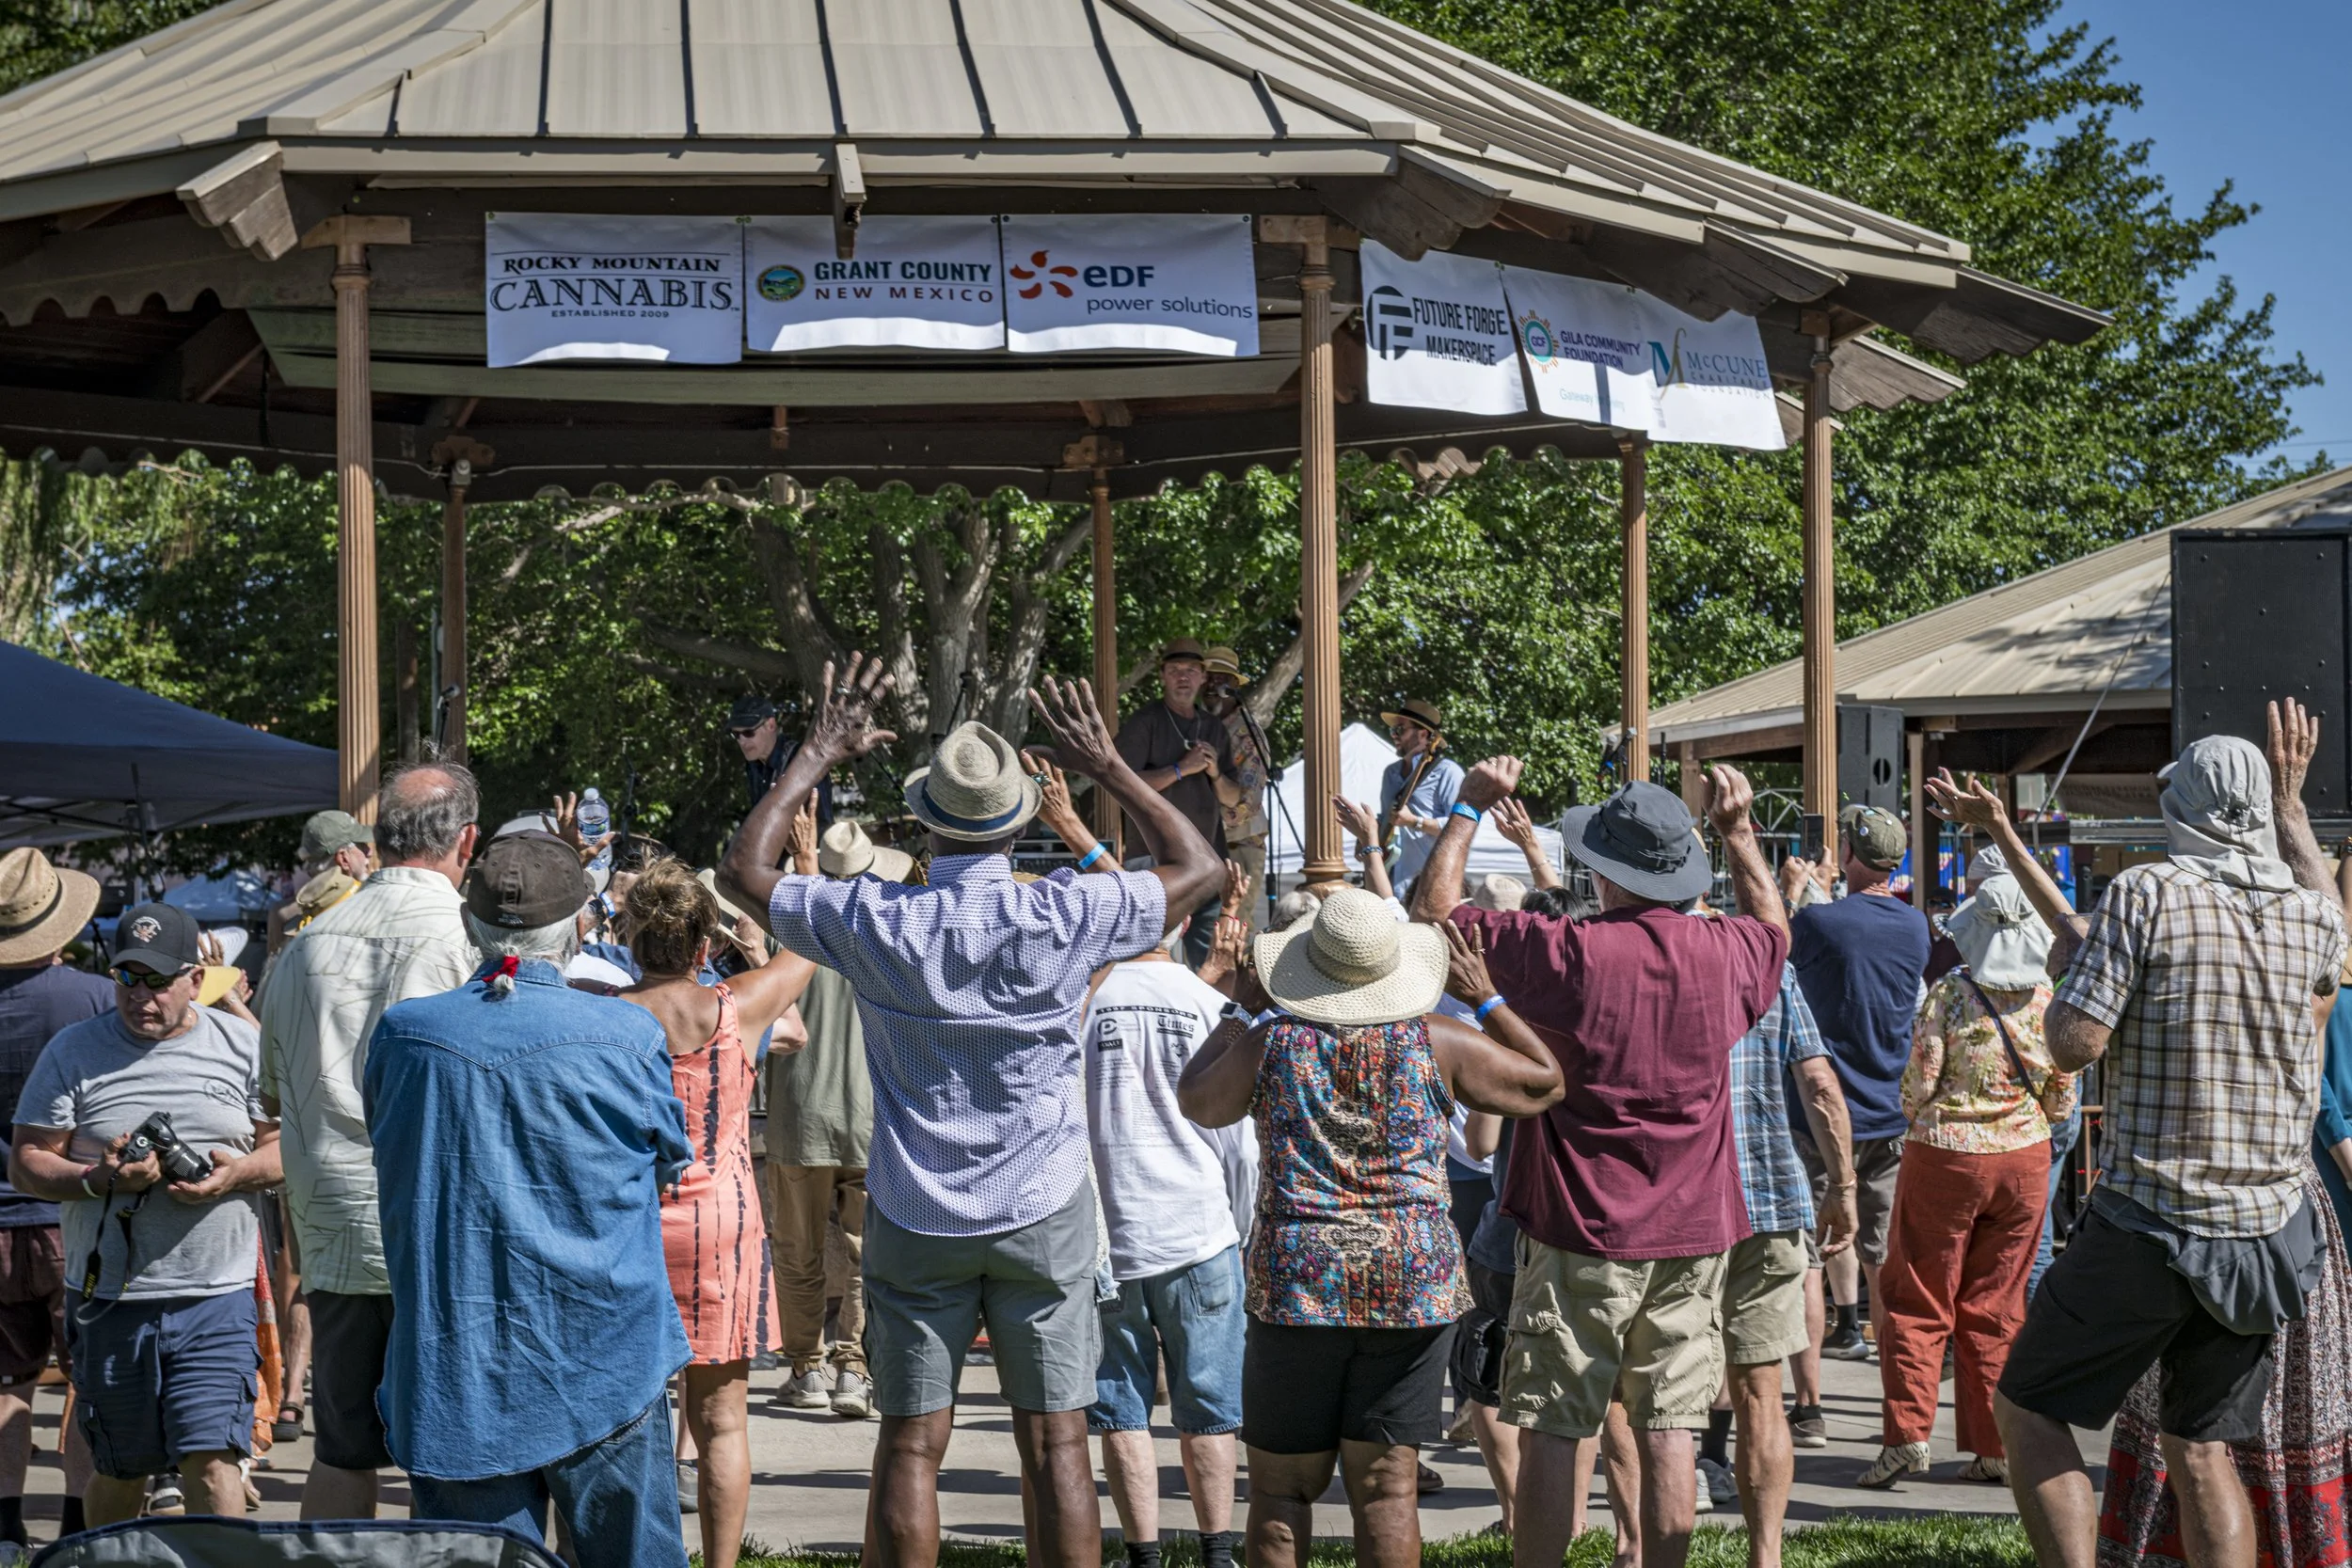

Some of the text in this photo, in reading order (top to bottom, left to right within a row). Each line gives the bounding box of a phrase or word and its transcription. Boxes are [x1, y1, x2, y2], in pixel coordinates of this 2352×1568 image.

[503, 256, 722, 275] ROCKY MOUNTAIN
[814, 261, 992, 282] GRANT COUNTY
[489, 278, 734, 311] CANNABIS
[816, 287, 993, 303] NEW MEXICO
[551, 309, 636, 318] ESTABLISHED
[1087, 297, 1253, 319] power solutions
[1412, 297, 1509, 336] FUTURE FORGE
[1426, 335, 1498, 366] MAKERSPACE
[1531, 336, 1548, 348] GCF
[1560, 330, 1641, 356] GILA COMMUNITY
[1564, 347, 1624, 369] FOUNDATION
[1685, 351, 1768, 378] McCUNE
[1131, 1006, 1194, 1019] SPONSORS
[1157, 1015, 1195, 1033] Times
